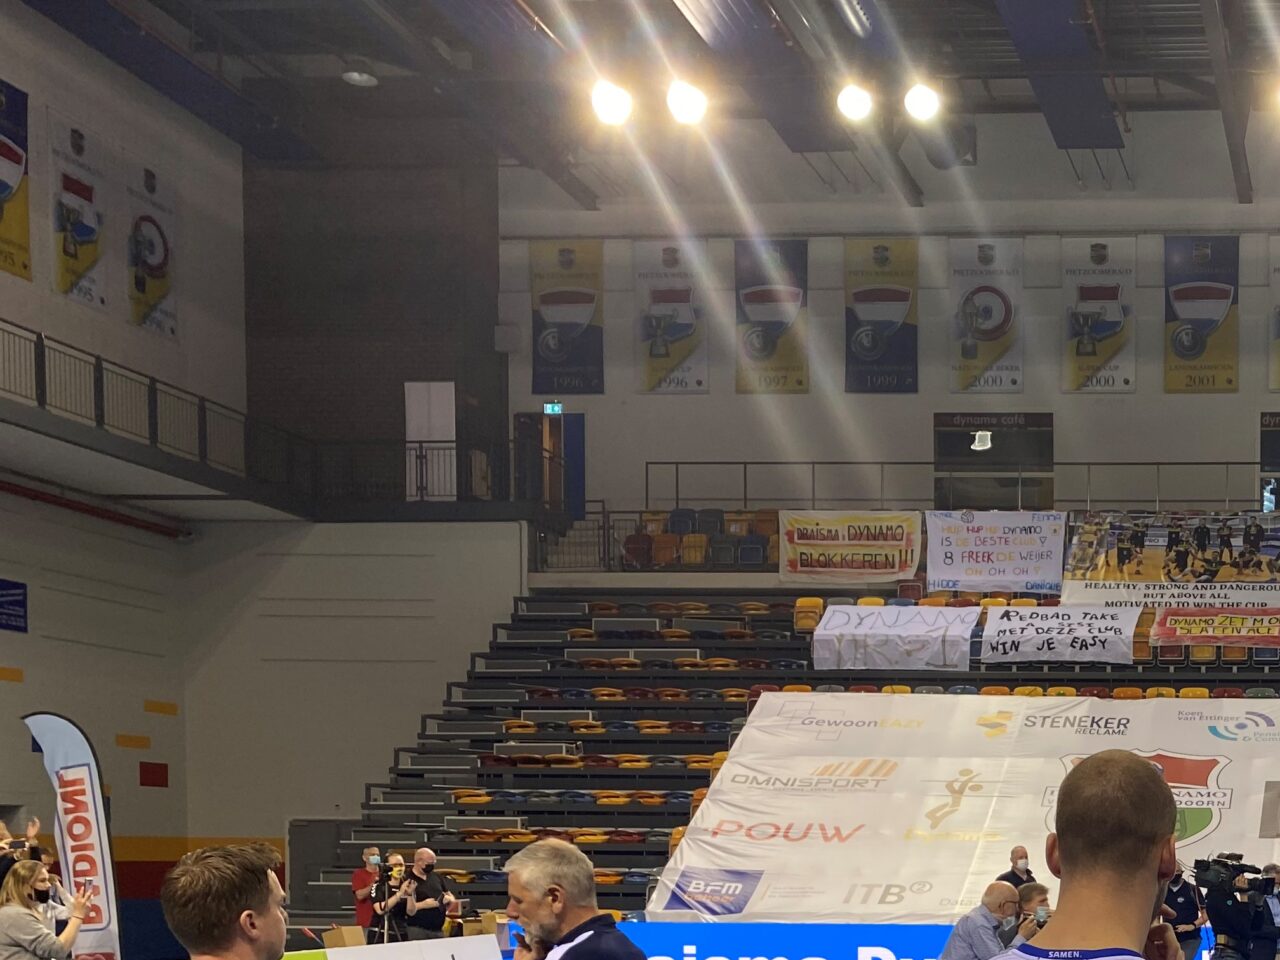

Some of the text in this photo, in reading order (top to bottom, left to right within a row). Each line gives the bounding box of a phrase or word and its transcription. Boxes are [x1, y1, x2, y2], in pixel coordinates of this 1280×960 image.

[971, 374, 1004, 388] 2000
[1083, 374, 1116, 388] 2000
[1184, 374, 1217, 388] 2001
[796, 522, 905, 541] DRAISMA DYNAMO
[966, 525, 1043, 535] HUP DYNAMO
[940, 536, 953, 547] IS
[974, 536, 1010, 547] BESTE
[943, 551, 954, 566] 8
[961, 551, 995, 564] FREEK
[988, 567, 1006, 576] OH
[1012, 567, 1029, 576] OH
[927, 580, 960, 590] HIDDE
[1144, 582, 1189, 591] STRONG
[1192, 583, 1217, 591] AND
[1143, 592, 1231, 600] BUT ABOVE ALL
[823, 608, 980, 630] DYNAMO
[1082, 611, 1120, 622] TAKE
[1169, 617, 1215, 627] DYNAMO
[1217, 615, 1246, 626] ZET
[997, 626, 1027, 636] MET
[1035, 626, 1077, 636] DEZE
[1087, 625, 1123, 637] CLUB
[989, 635, 1109, 655] WIN JE EASY
[1023, 715, 1131, 729] STENEKER
[1074, 728, 1128, 736] RECLAME
[730, 774, 888, 788] OMNISPORT
[710, 818, 867, 844] POUW
[842, 883, 908, 905] ITB
